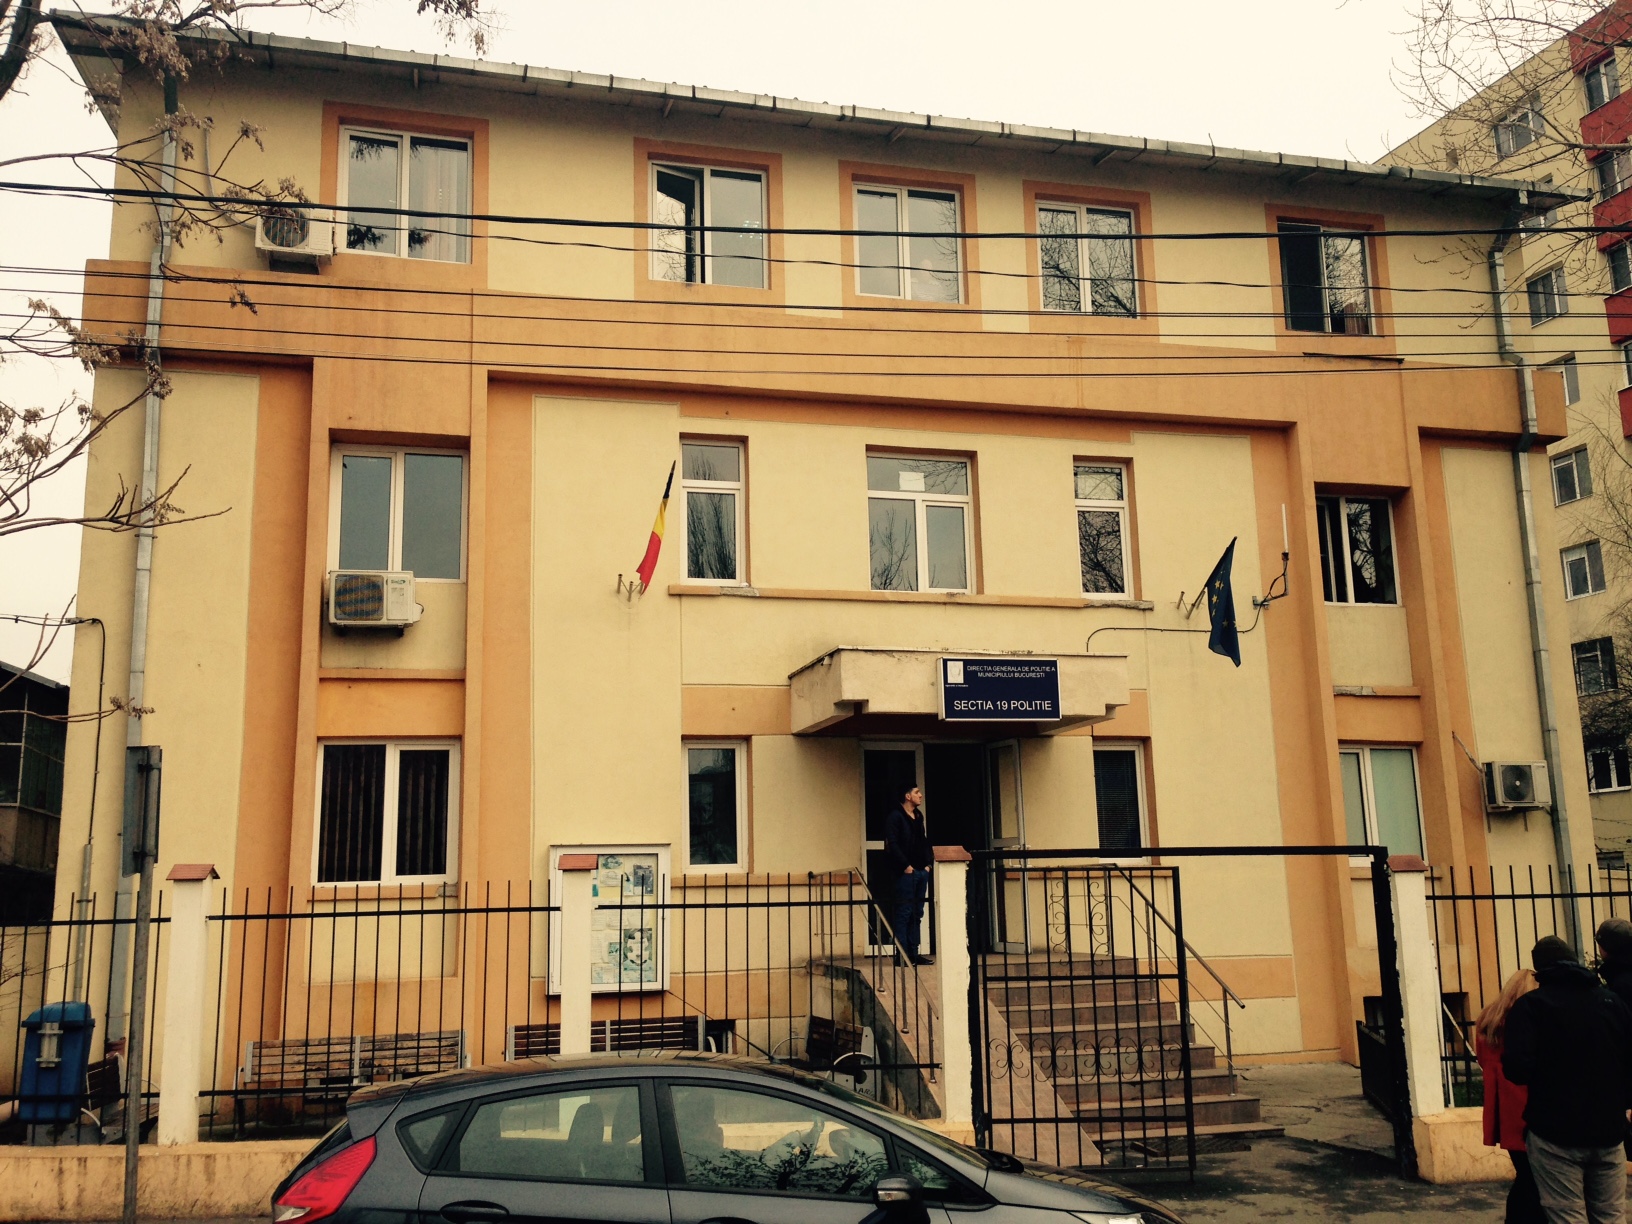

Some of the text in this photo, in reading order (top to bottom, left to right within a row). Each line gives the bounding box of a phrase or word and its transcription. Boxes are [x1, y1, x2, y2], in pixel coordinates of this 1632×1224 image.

[954, 700, 1052, 710] SECTIA 19 POLITIE
